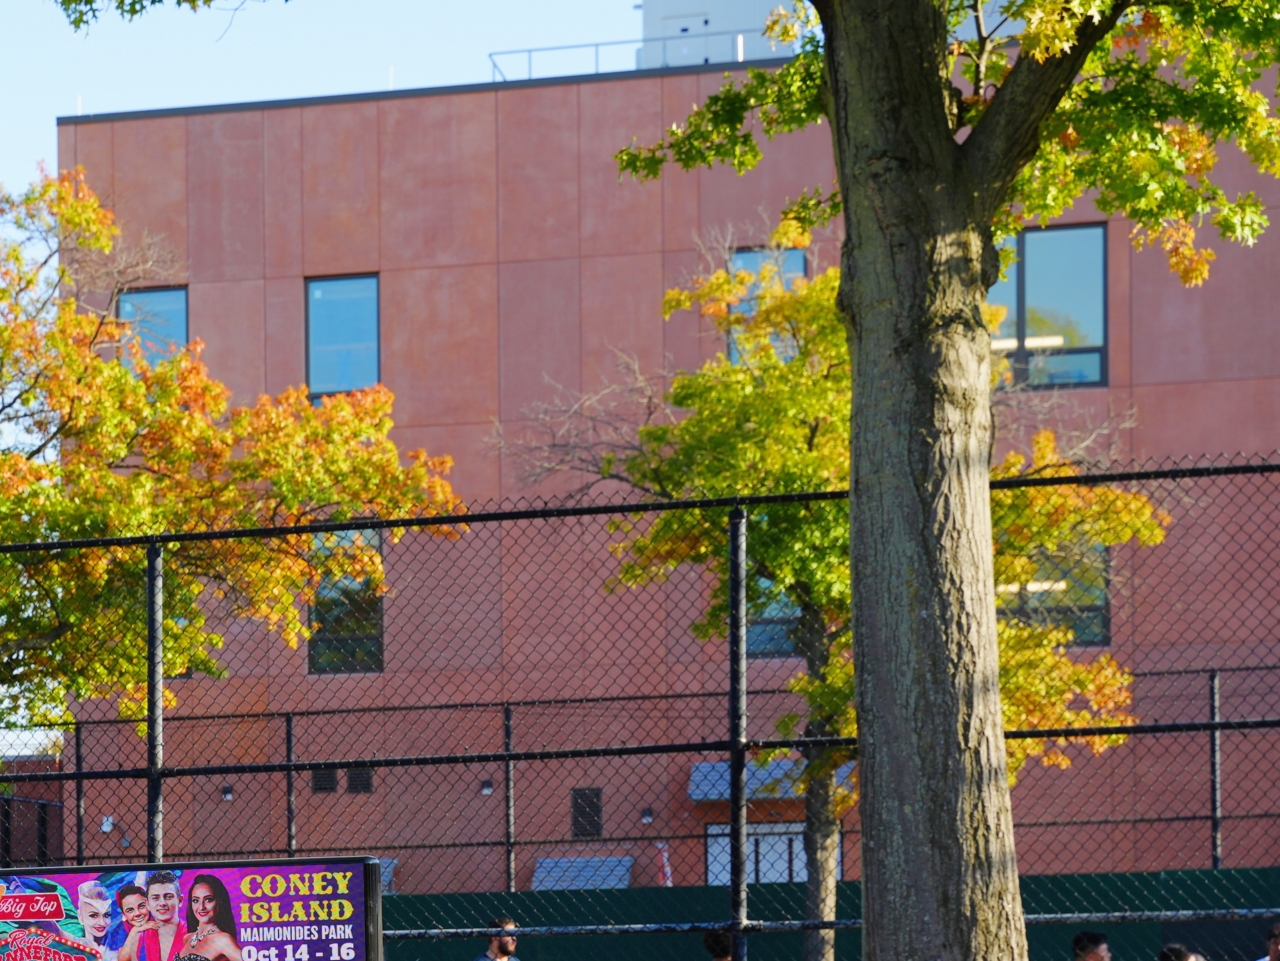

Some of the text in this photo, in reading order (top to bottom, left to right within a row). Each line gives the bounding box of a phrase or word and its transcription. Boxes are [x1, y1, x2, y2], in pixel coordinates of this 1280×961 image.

[240, 872, 353, 897] CONEY
[29, 896, 57, 916] Top
[240, 899, 354, 923] ISLAND
[8, 929, 56, 949] Royal
[240, 924, 353, 942] MAIMONIDES PARK
[284, 944, 309, 961] 14
[329, 943, 356, 961] 16
